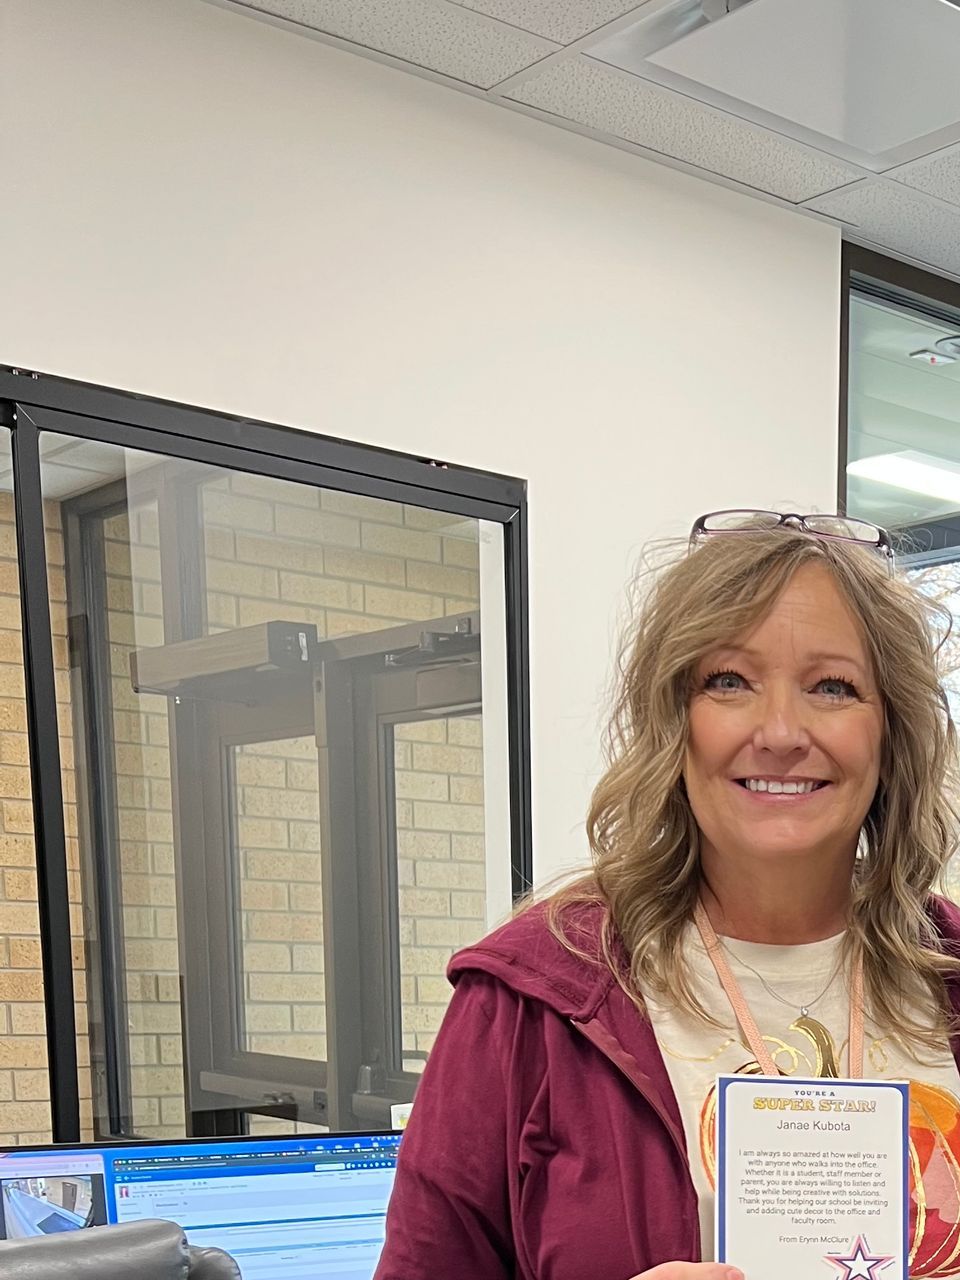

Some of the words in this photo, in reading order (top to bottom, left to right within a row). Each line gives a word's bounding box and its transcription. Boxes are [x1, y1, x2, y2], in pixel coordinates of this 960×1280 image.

[753, 1097, 815, 1111] SUPER
[819, 1099, 877, 1113] STAR!
[777, 1120, 810, 1130] Janae
[813, 1120, 851, 1131] Kubota
[756, 1150, 781, 1158] always
[797, 1170, 825, 1178] student,
[741, 1179, 766, 1187] parent,
[794, 1179, 818, 1187] always
[820, 1180, 842, 1188] willing
[745, 1188, 760, 1196] help
[761, 1188, 780, 1196] while
[782, 1189, 801, 1197] being
[739, 1197, 760, 1205] Thank
[788, 1198, 814, 1206] helping
[863, 1199, 888, 1207] inviting
[761, 1207, 785, 1215] adding
[791, 1217, 815, 1225] faculty
[799, 1236, 818, 1245] Erynn
